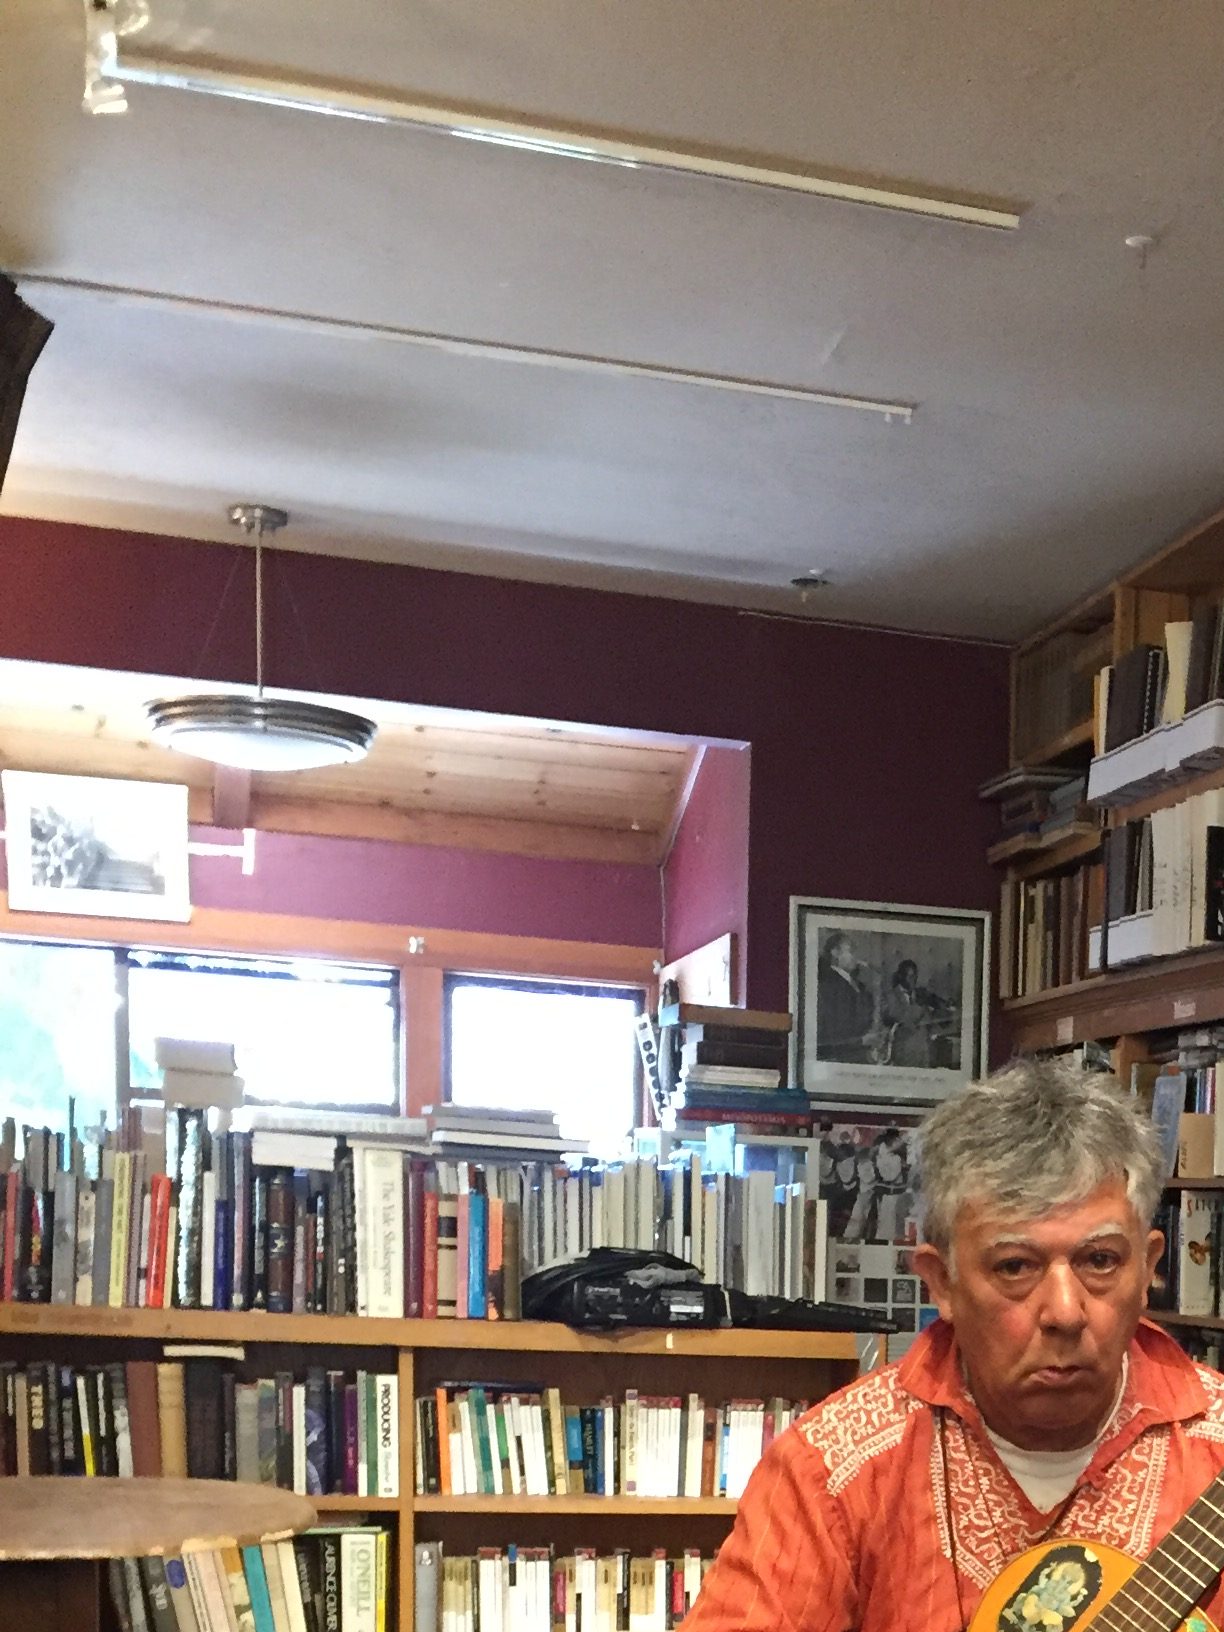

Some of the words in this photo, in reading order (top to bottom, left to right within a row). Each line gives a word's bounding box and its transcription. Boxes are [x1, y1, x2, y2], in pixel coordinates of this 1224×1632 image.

[382, 1181, 395, 1202] The
[379, 1231, 396, 1298] Shakespeare
[381, 1383, 392, 1449] PRODUCING
